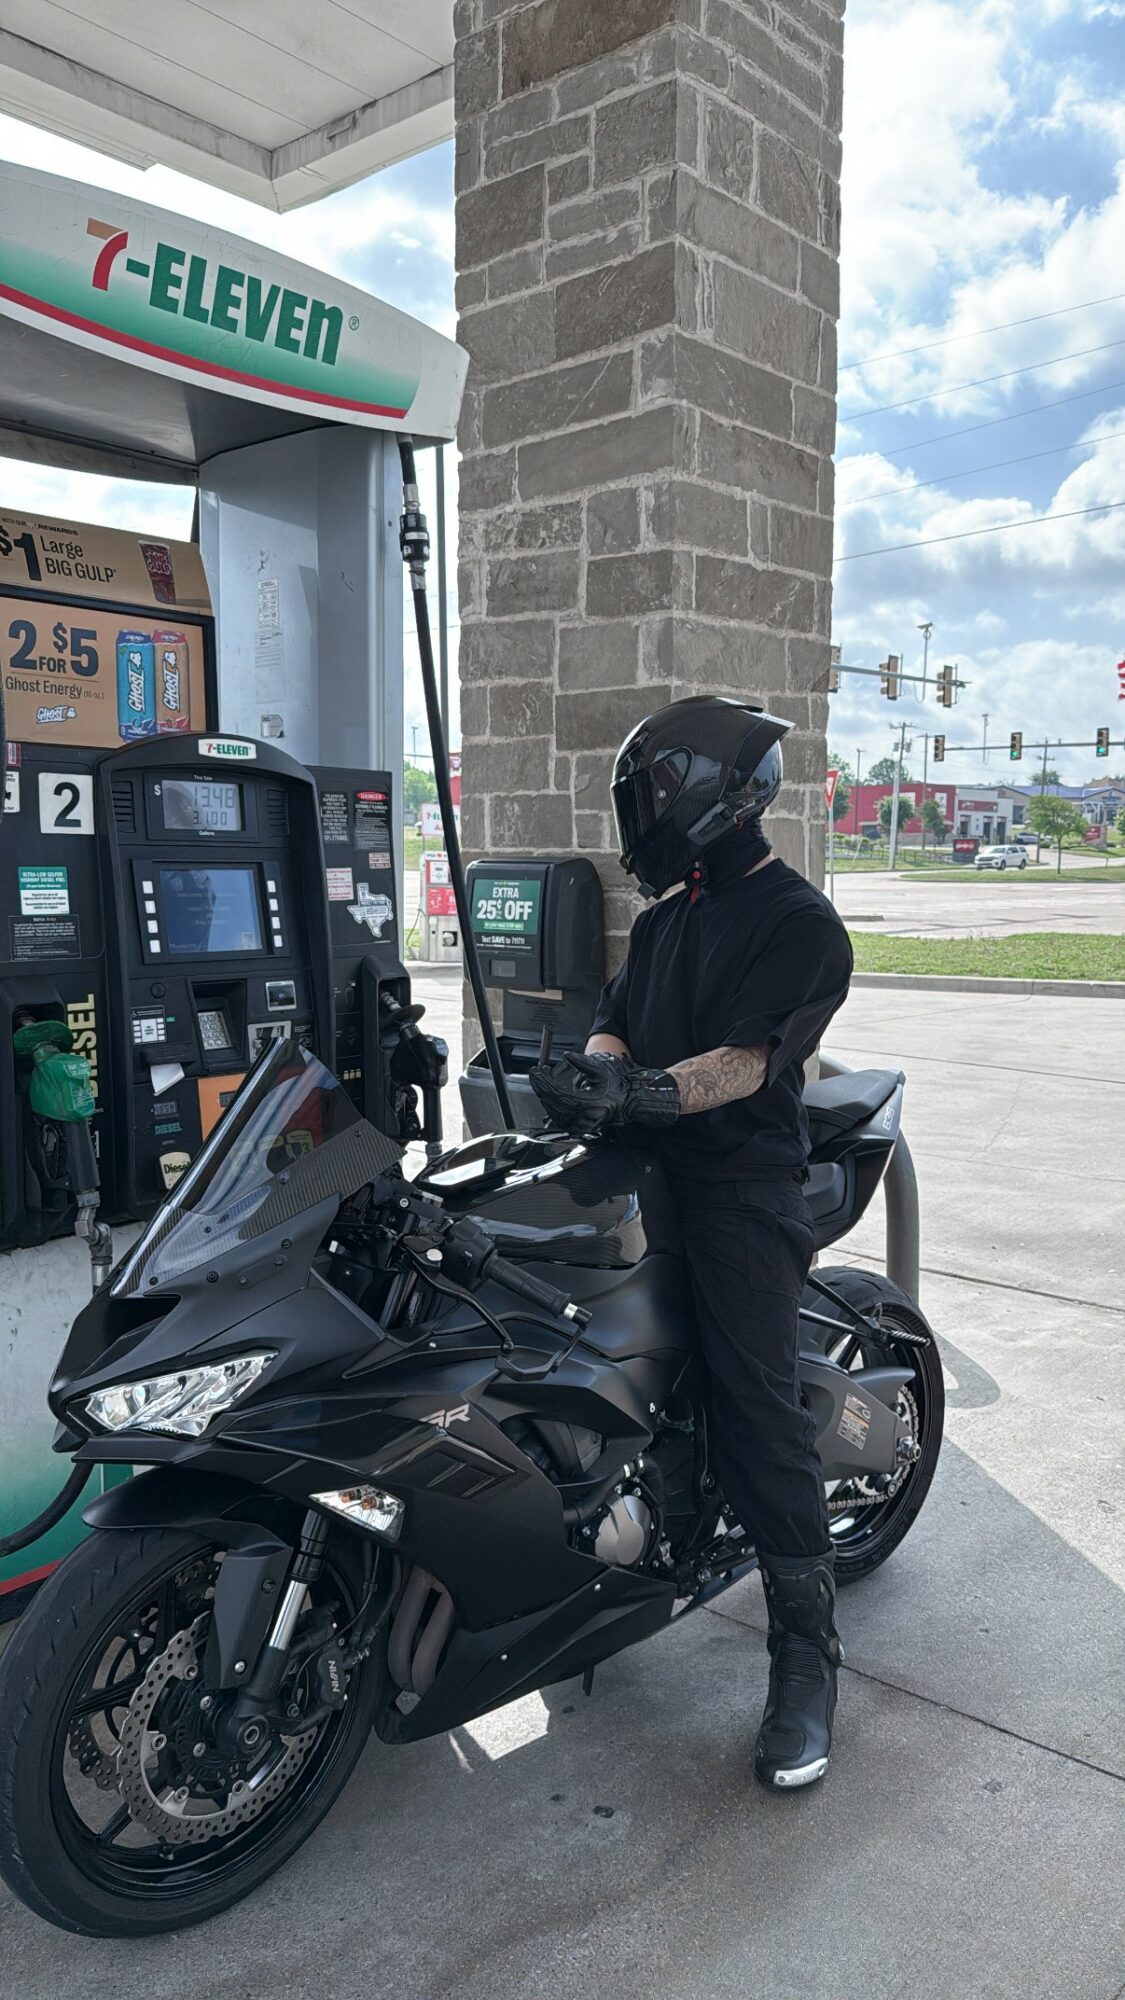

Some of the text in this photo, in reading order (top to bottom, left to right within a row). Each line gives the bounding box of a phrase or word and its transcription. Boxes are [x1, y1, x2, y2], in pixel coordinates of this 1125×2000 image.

[39, 535, 83, 560] Large
[45, 557, 114, 583] BIG GULP
[8, 619, 99, 677] 2 FOR $5
[5, 676, 41, 693] Ghost
[43, 680, 82, 700] Energy
[128, 666, 146, 714] GHOST
[163, 666, 181, 714] GHOST
[36, 705, 68, 724] GHOST
[153, 784, 161, 796] $
[53, 782, 82, 828] 2
[492, 887, 520, 899] EXTRA
[504, 900, 534, 921] OFF
[491, 935, 505, 944] SAVE
[154, 1122, 183, 1136] DIESEL
